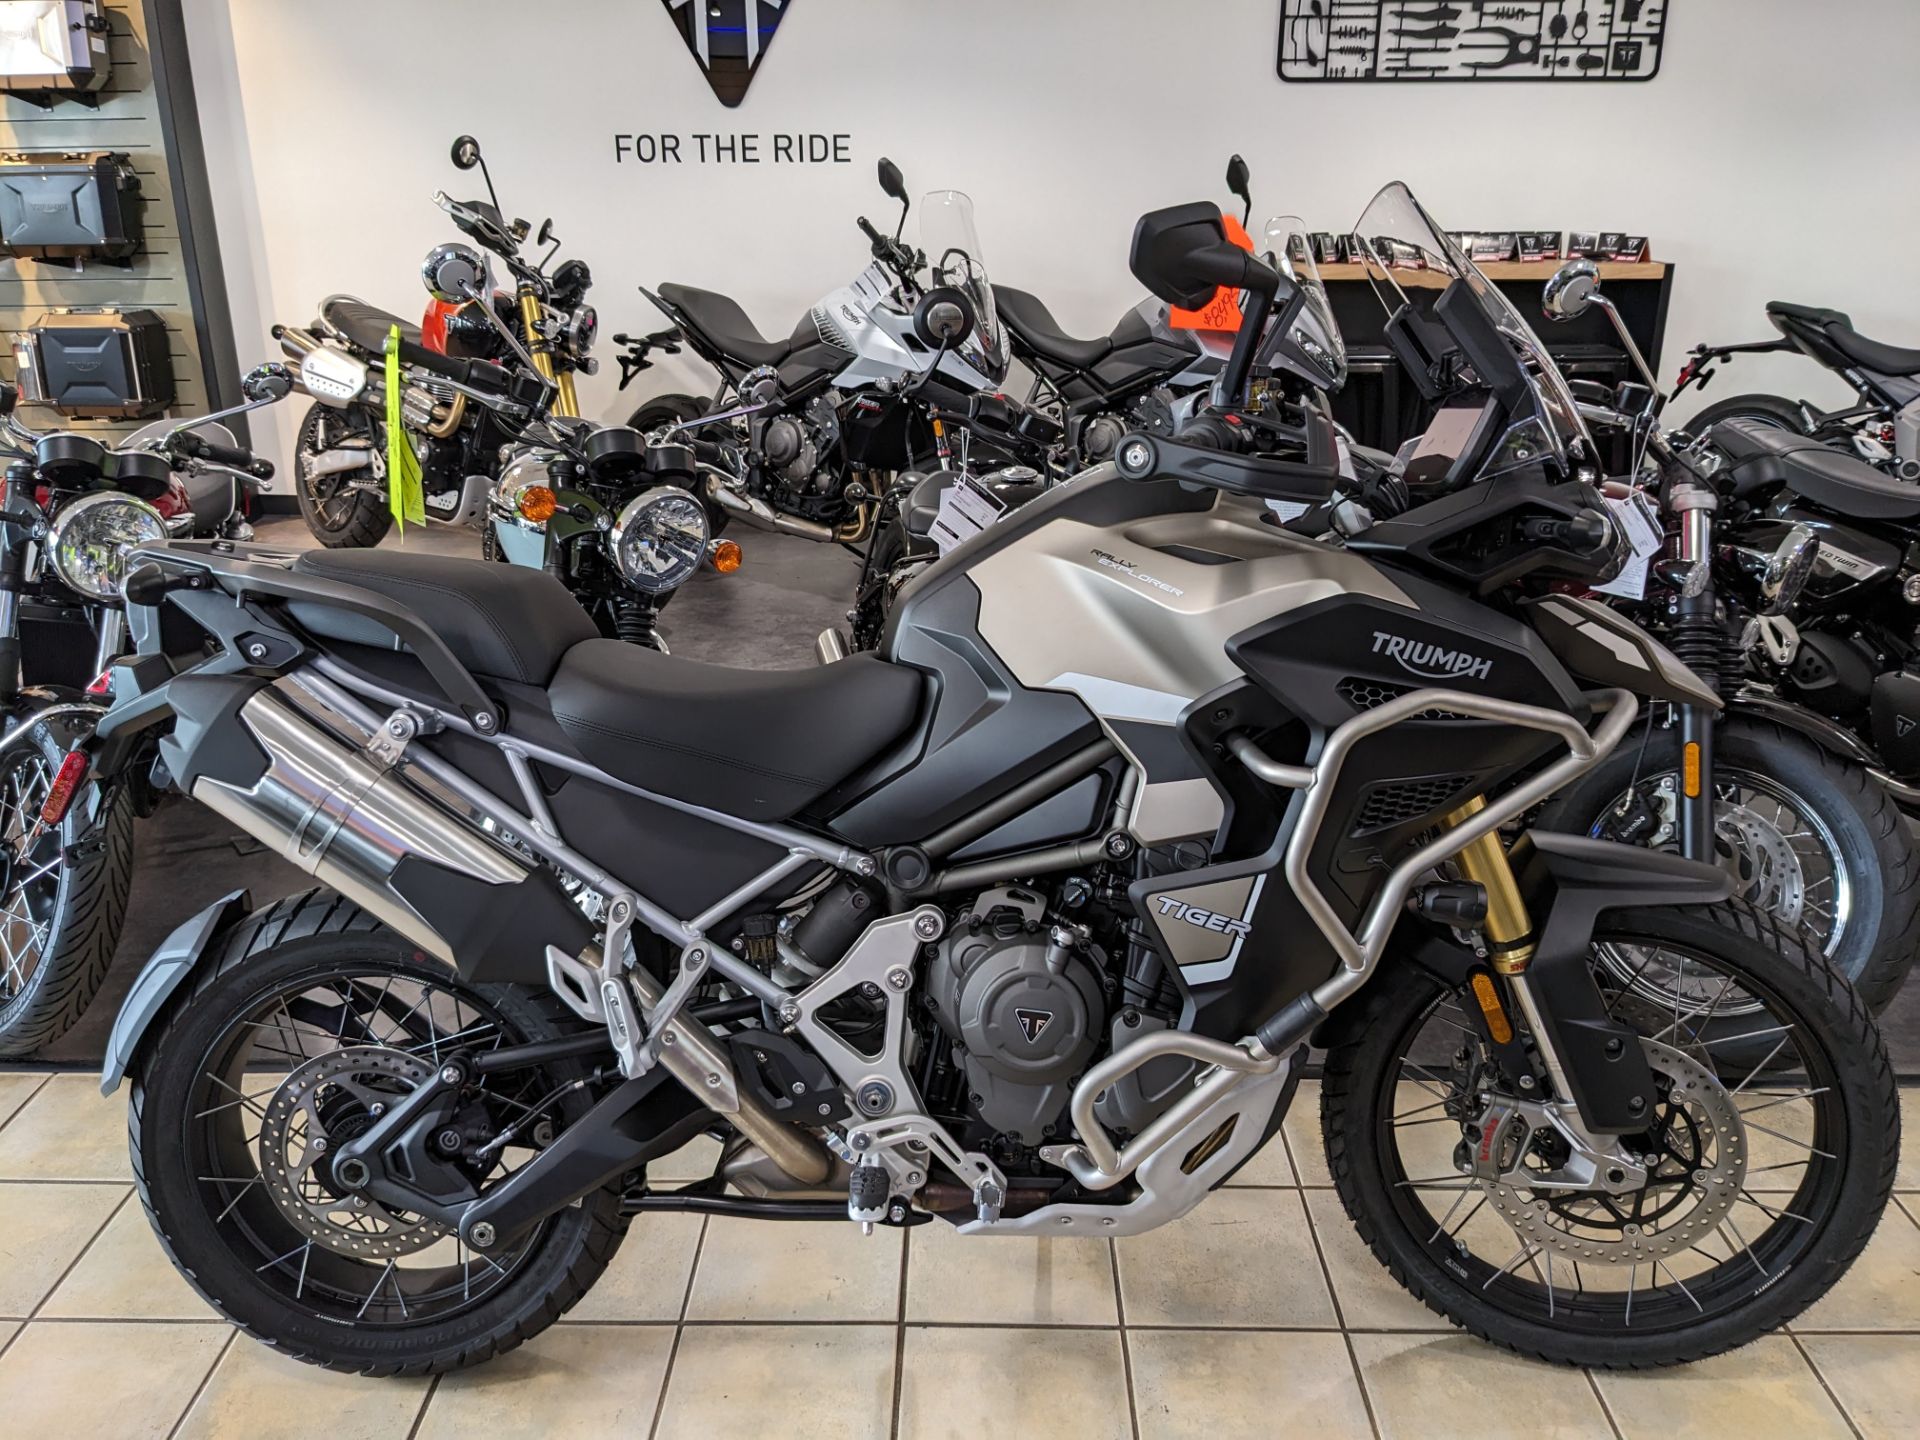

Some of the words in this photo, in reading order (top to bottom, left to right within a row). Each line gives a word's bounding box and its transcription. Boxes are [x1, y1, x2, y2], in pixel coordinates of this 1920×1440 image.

[614, 134, 682, 163] FOR
[692, 134, 760, 163] THE
[773, 134, 852, 163] RIDE
[1090, 548, 1138, 569] RALLY
[1832, 555, 1859, 569] TWIN
[1097, 558, 1184, 597] EXPLORER
[1371, 631, 1493, 680] TRIUMPH
[1157, 895, 1253, 940] TIGER
